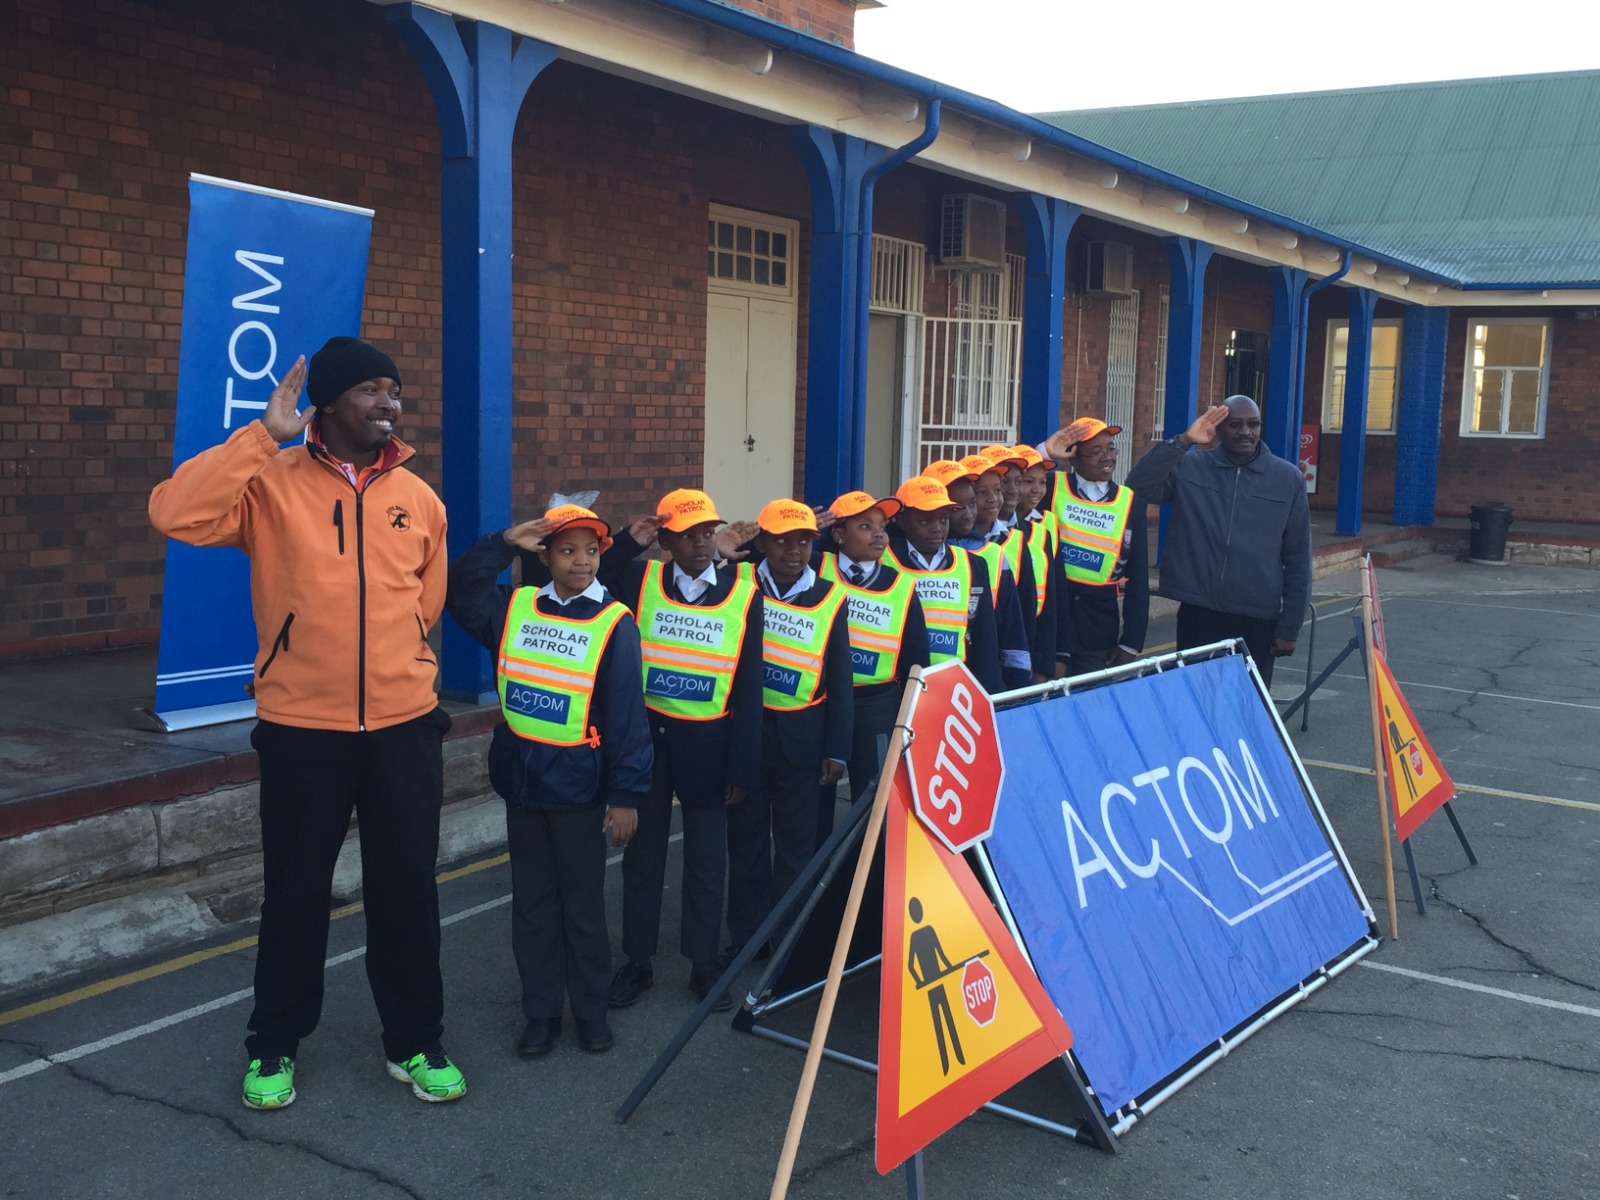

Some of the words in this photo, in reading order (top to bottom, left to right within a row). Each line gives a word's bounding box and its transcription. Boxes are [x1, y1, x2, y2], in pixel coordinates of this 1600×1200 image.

[224, 249, 285, 429] TOM
[674, 499, 705, 511] SCHOLAR
[679, 506, 706, 515] PATROL
[779, 508, 808, 517] SCHOLAR
[1066, 504, 1115, 522] SCHOLAR
[782, 513, 807, 521] PATROL
[1068, 513, 1107, 529] PATROL
[1061, 546, 1100, 564] ACTOM
[918, 580, 959, 590] HOLAR
[916, 590, 955, 600] ATROL
[848, 597, 891, 617] HOLAR
[655, 612, 724, 632] SCHOLAR
[763, 607, 815, 631] CHOLAR
[849, 609, 881, 626] TROL
[521, 624, 589, 646] SCHOLAR
[659, 625, 714, 643] PATROL
[763, 620, 805, 640] ATROL
[928, 632, 955, 646] TOM
[522, 637, 576, 657] PATROL
[654, 673, 711, 692] ACTOM
[765, 666, 796, 685] TOM
[511, 688, 565, 712] ACTOM
[928, 682, 982, 826] STOP
[1061, 738, 1280, 909] ACTOM
[965, 975, 992, 1009] STOP
